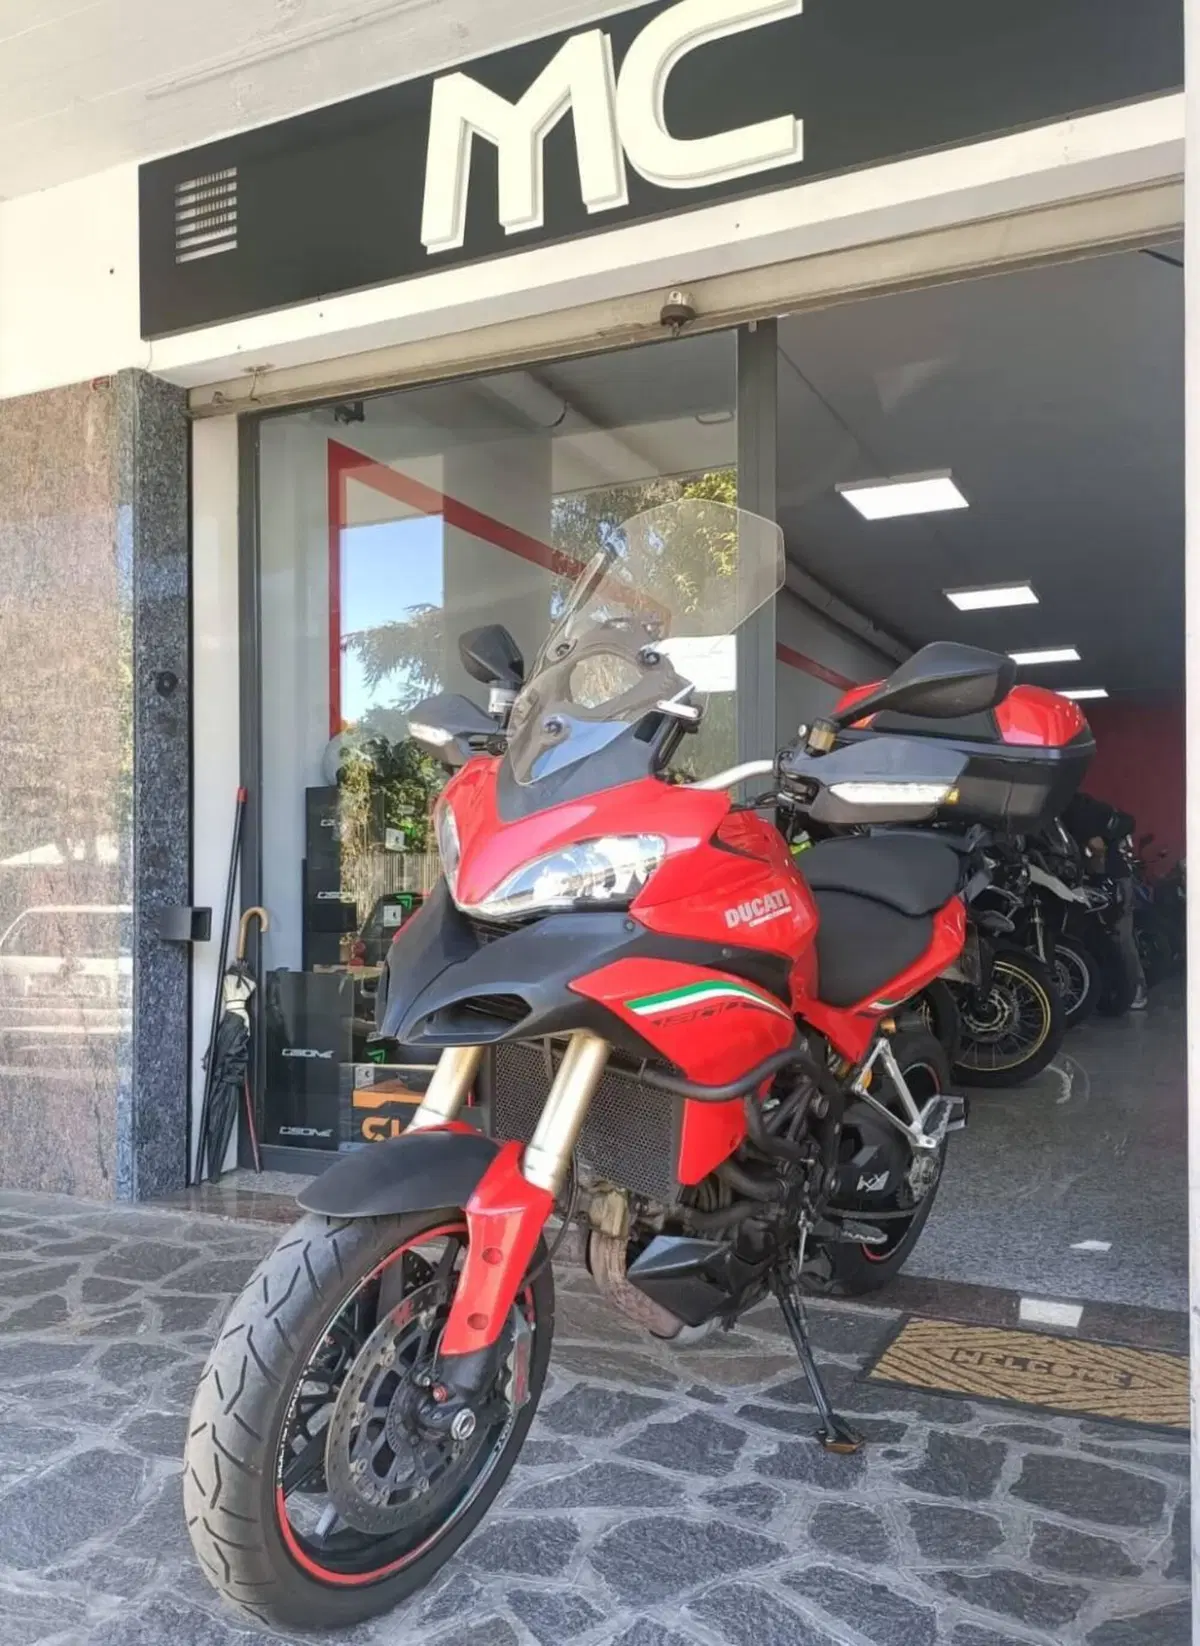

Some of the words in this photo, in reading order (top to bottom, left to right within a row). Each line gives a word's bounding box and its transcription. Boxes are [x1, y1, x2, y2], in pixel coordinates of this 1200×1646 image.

[420, 0, 804, 255] MC
[724, 888, 790, 928] DUCATI
[952, 1348, 1131, 1388] WELCOME
